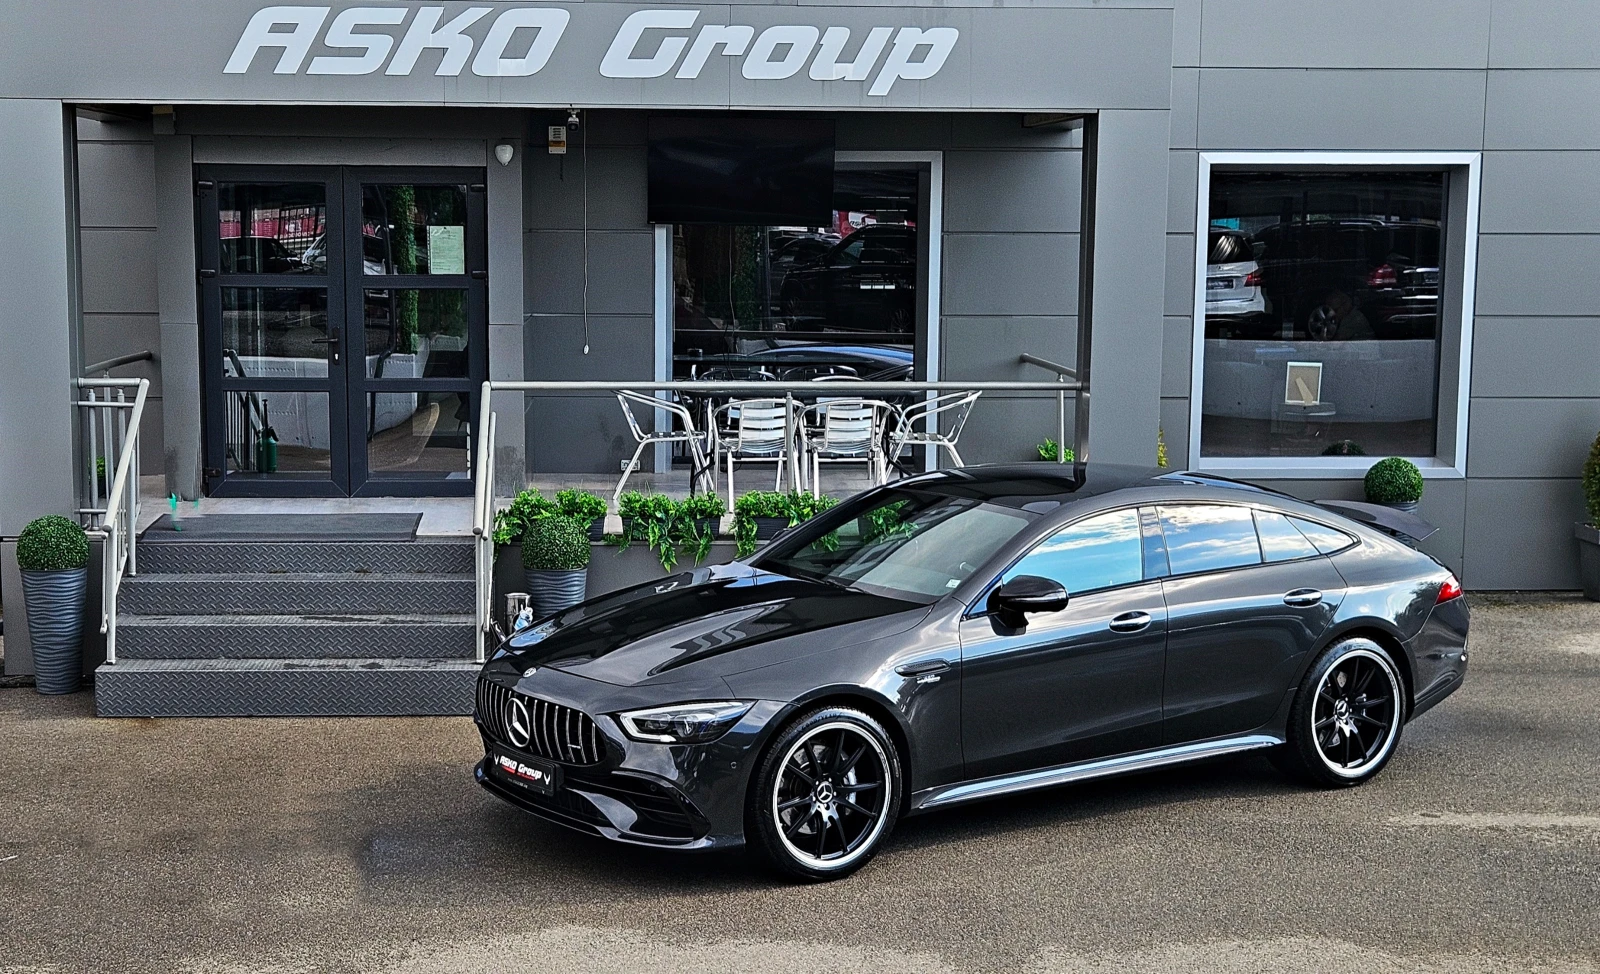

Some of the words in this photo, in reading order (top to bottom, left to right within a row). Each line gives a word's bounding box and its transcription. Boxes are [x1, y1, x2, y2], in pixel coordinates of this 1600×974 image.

[222, 6, 571, 77] ASKO
[599, 10, 960, 96] Group
[500, 755, 518, 770] ASKO
[517, 763, 543, 780] Group
